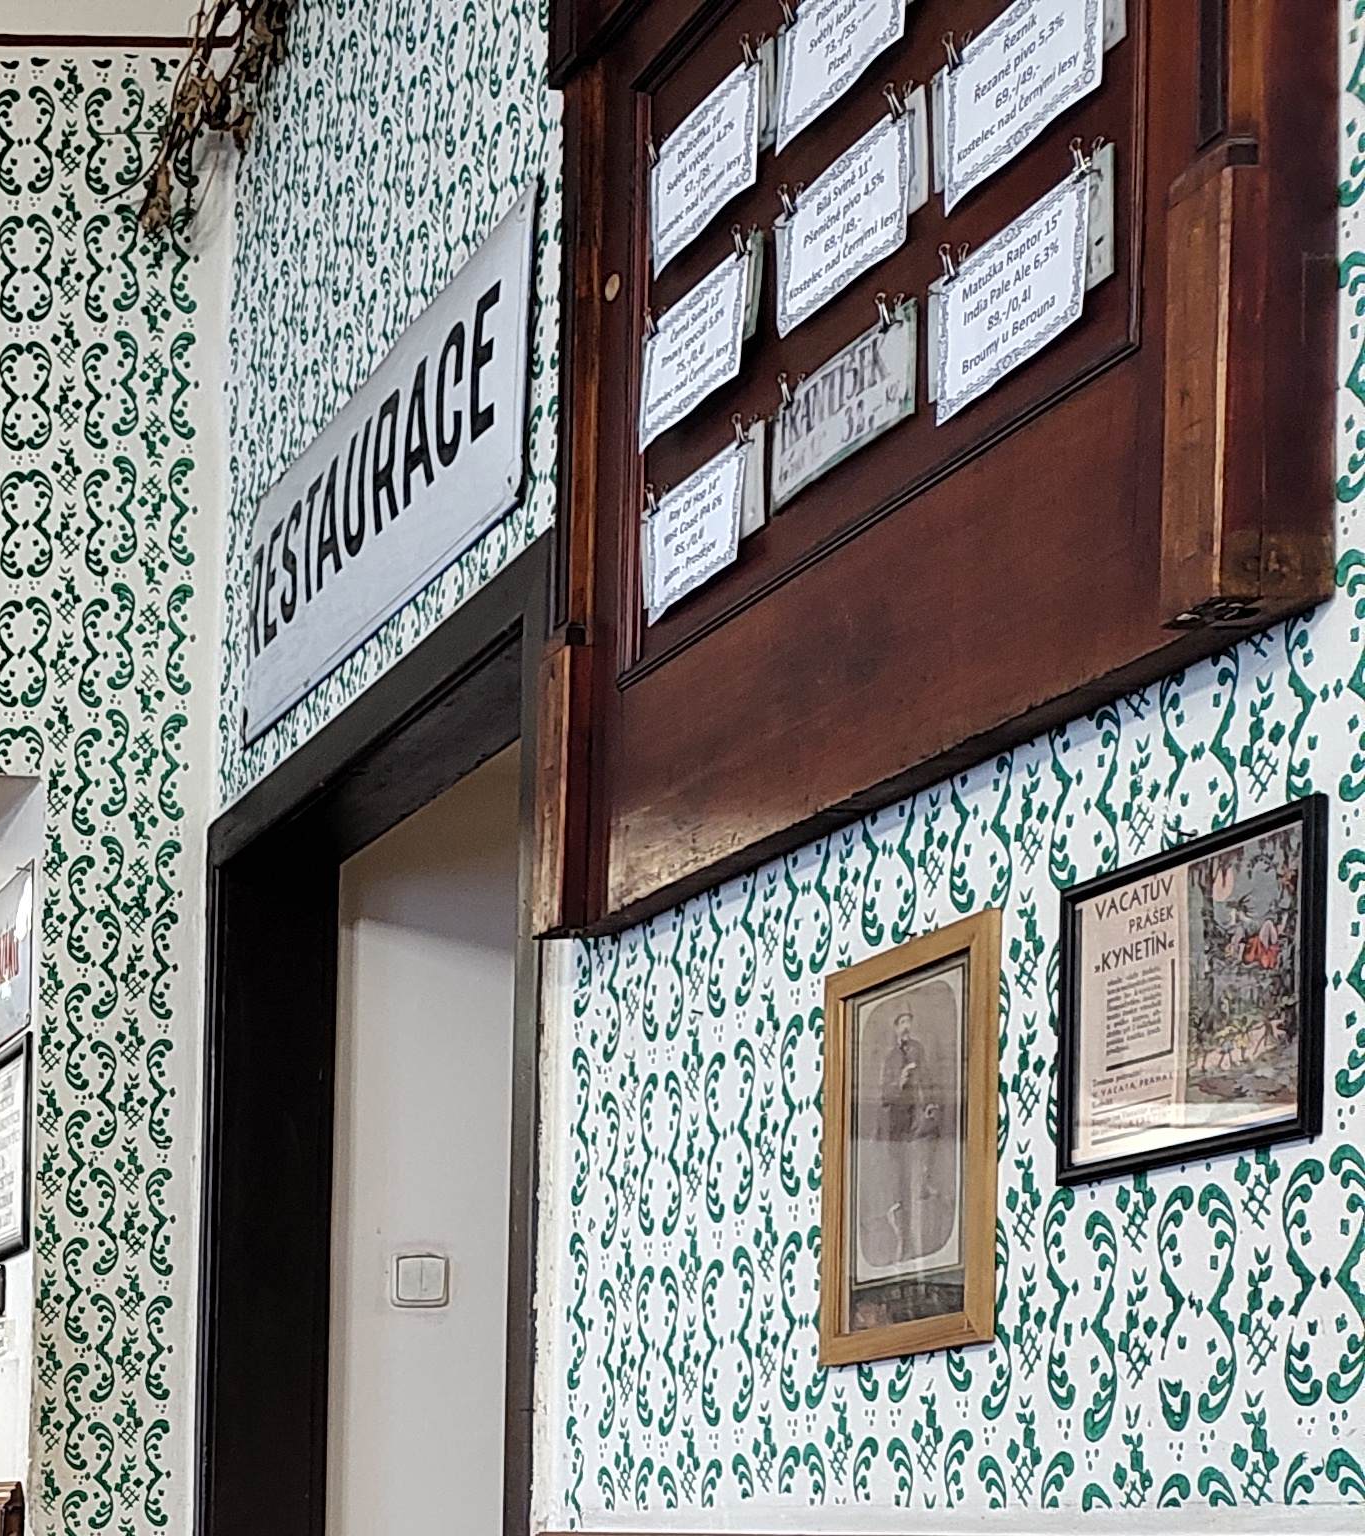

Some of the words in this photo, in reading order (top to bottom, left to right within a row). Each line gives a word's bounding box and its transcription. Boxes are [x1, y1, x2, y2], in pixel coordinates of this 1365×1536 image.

[973, 61, 1011, 104] Řezané
[1014, 40, 1036, 71] pivo
[1038, 13, 1065, 48] 5,3%
[1003, 13, 1038, 53] Řezník
[956, 124, 995, 165] Kostelec
[997, 105, 1017, 130] nad
[1018, 69, 1056, 113] Černými
[1057, 51, 1080, 76] lesy
[995, 64, 1041, 110] 69,-/49,-
[832, 173, 857, 201] Svině
[858, 155, 873, 178] 11°
[803, 206, 840, 249] Pšeničné
[842, 193, 862, 223] pivo
[824, 249, 841, 274] nad
[880, 209, 900, 231] lesy
[961, 259, 1004, 303] Matuška
[1005, 230, 1043, 272] Raptor
[1044, 209, 1063, 238] 15°
[963, 298, 989, 327] India
[990, 278, 1011, 305] Pale
[1013, 263, 1031, 288] Ale
[1033, 238, 1060, 272] 6,3%
[961, 336, 1000, 375] Broumy
[1001, 330, 1010, 344] u
[1011, 293, 1056, 337] Berouna
[1129, 904, 1174, 934] PRÁŠEK
